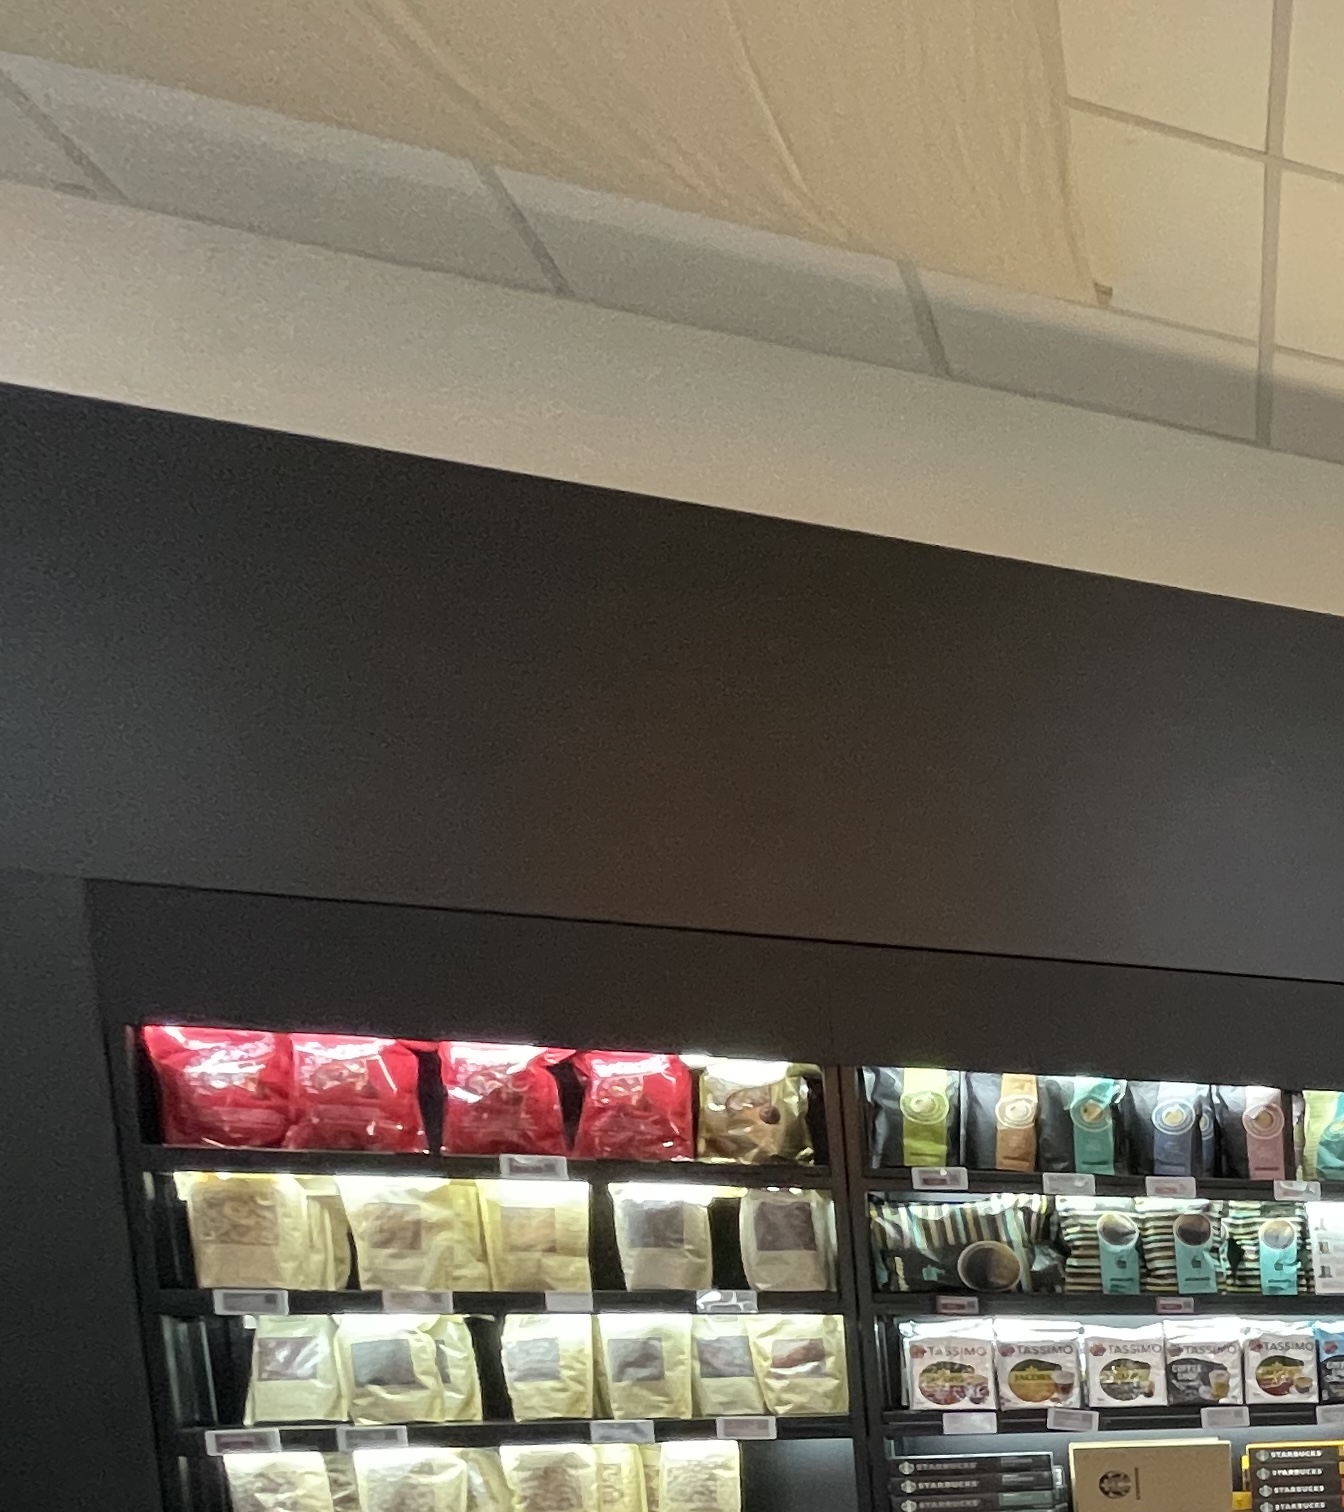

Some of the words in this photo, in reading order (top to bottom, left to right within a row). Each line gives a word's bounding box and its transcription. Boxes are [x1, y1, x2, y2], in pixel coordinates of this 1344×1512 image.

[927, 1345, 987, 1357] TASSIMO
[1016, 1344, 1073, 1355] TASSIMO
[1108, 1343, 1162, 1354] TASSIMO
[1263, 1341, 1314, 1352] TASSIMO
[1271, 1450, 1322, 1458] STARBUCKS
[916, 1462, 978, 1472] STARBUCKS
[1272, 1468, 1323, 1476] STARBUCKS
[918, 1480, 980, 1490] STARBUCKS
[1274, 1485, 1325, 1494] STARBUCKS
[918, 1500, 981, 1509] STARBUCKS
[1275, 1502, 1326, 1511] STARBUCKS
